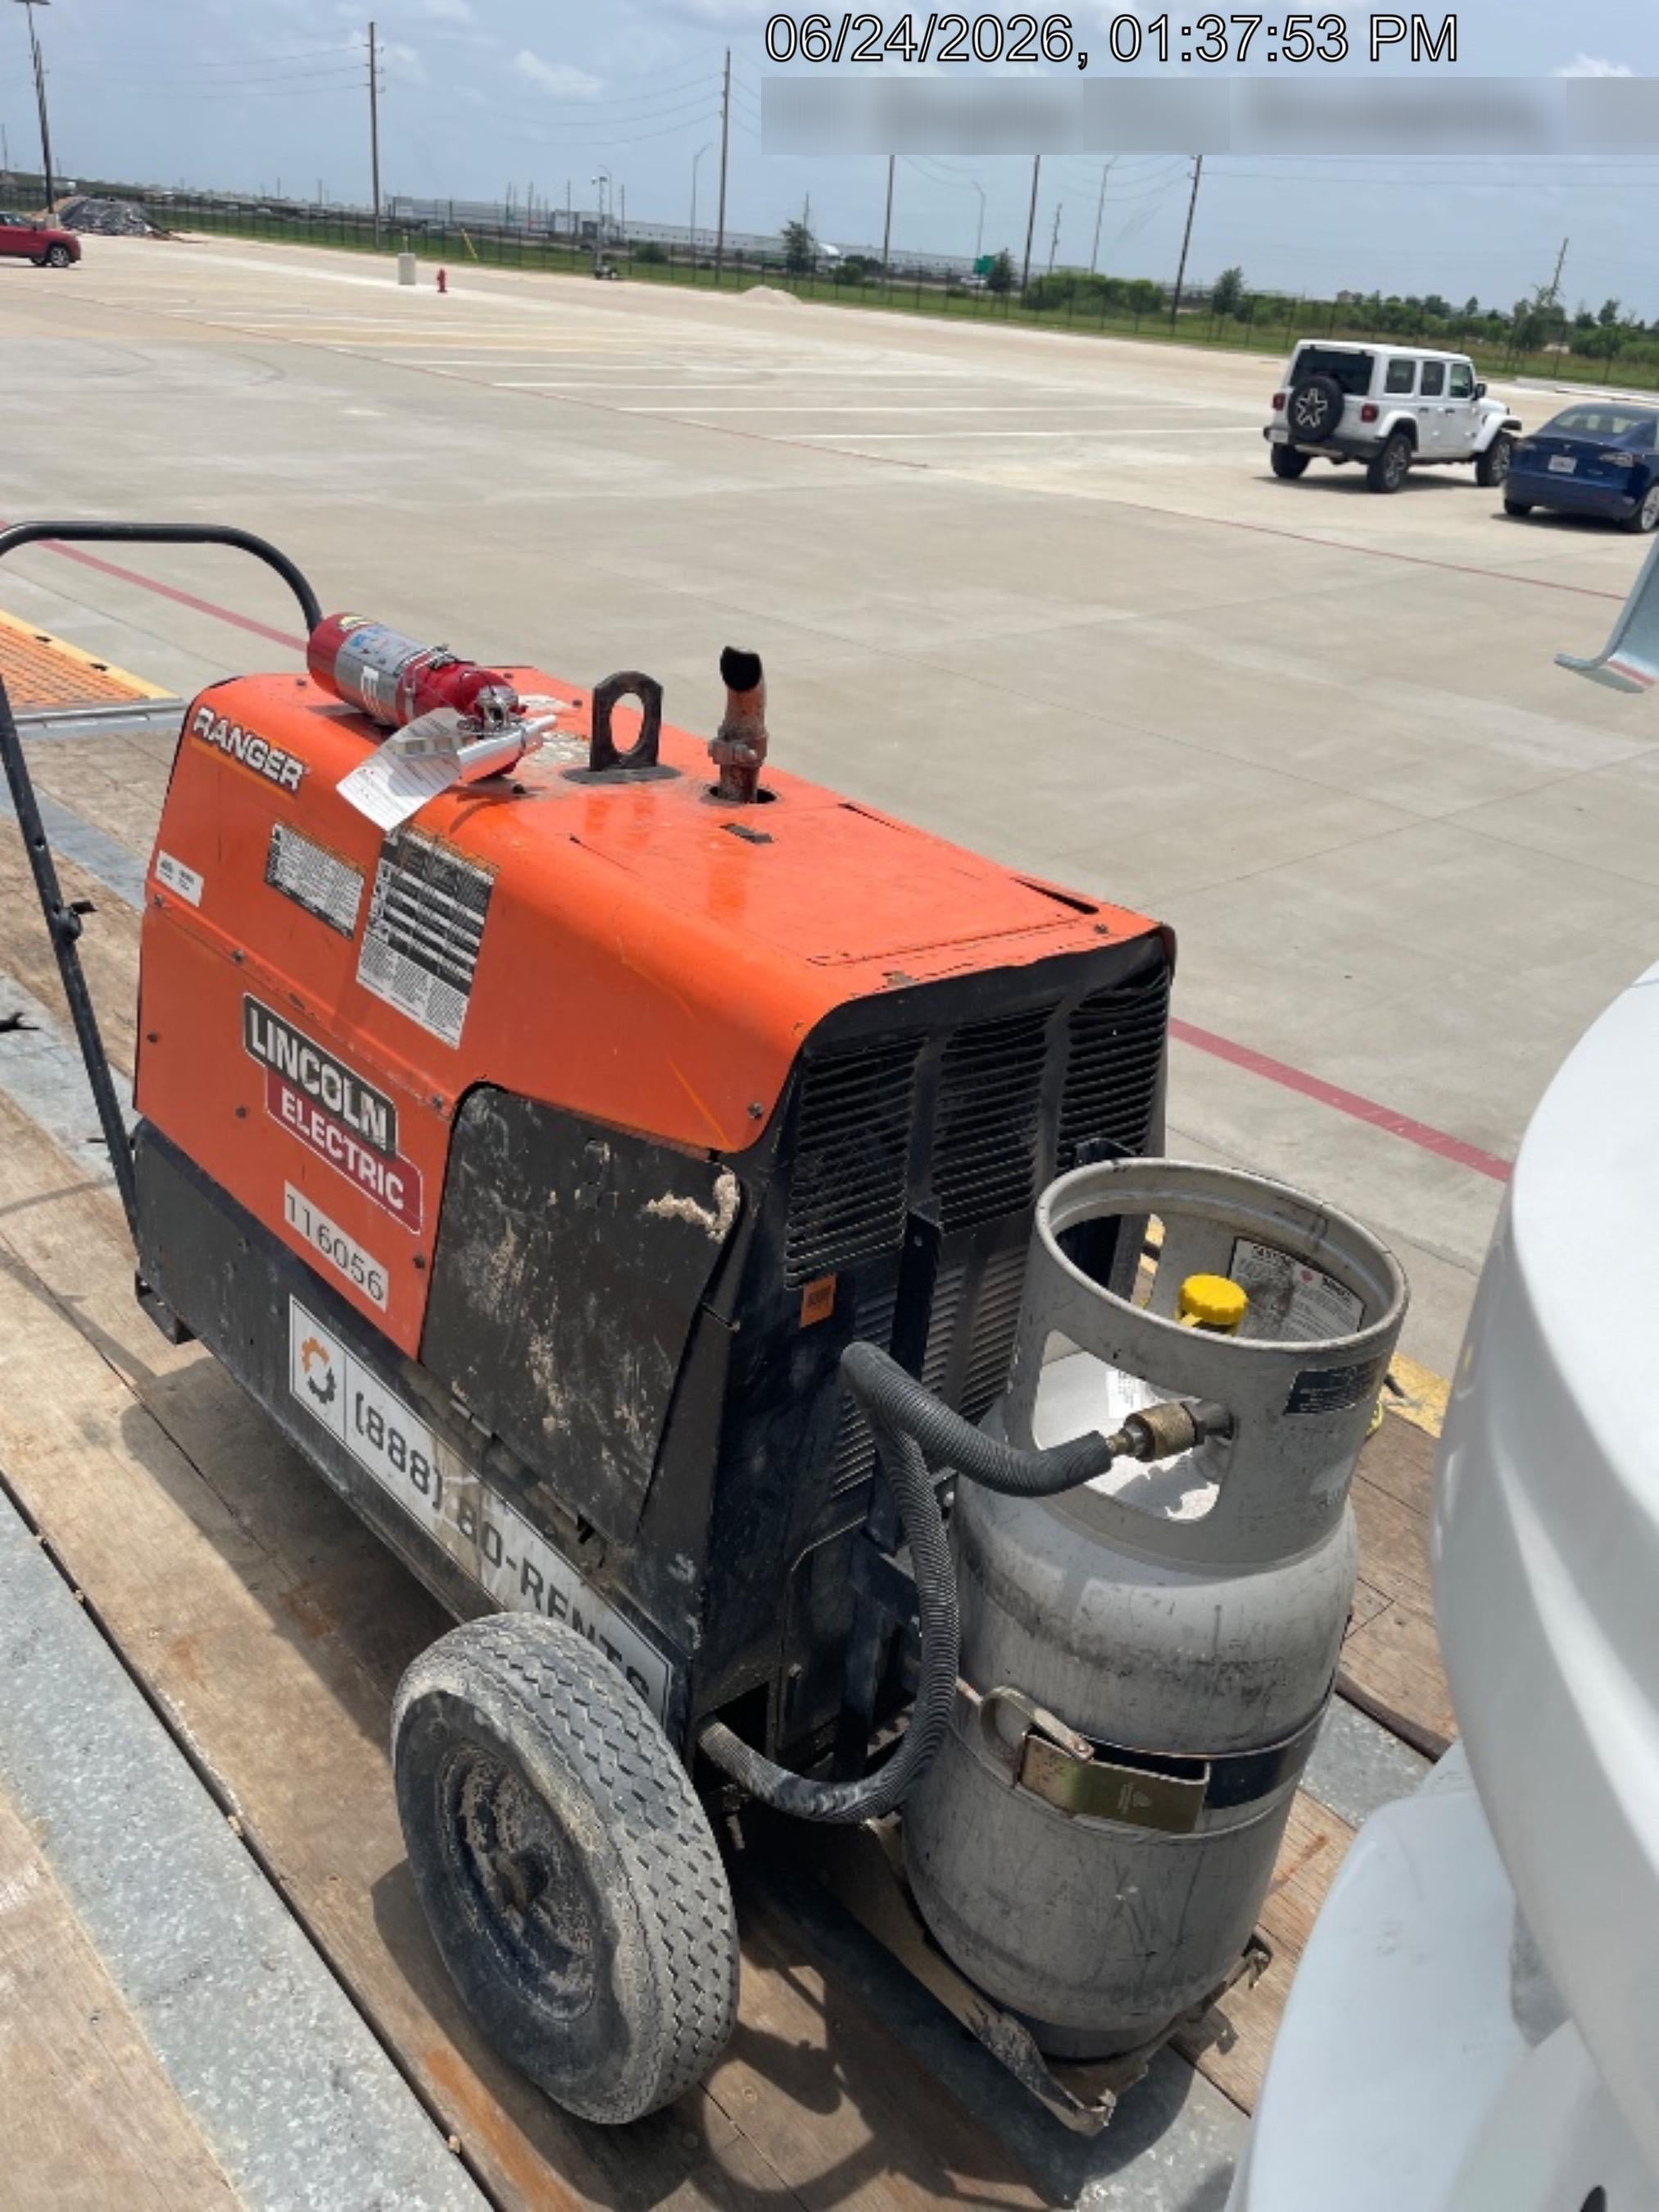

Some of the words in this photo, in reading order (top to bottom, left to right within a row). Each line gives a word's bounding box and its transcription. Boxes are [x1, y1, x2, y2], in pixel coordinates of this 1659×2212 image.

[193, 706, 304, 791] RANGER
[249, 1007, 387, 1151] LINCOLN
[281, 1086, 405, 1211] ELECTRIC
[286, 1193, 384, 1303] 116056
[356, 1390, 443, 1511] (888)
